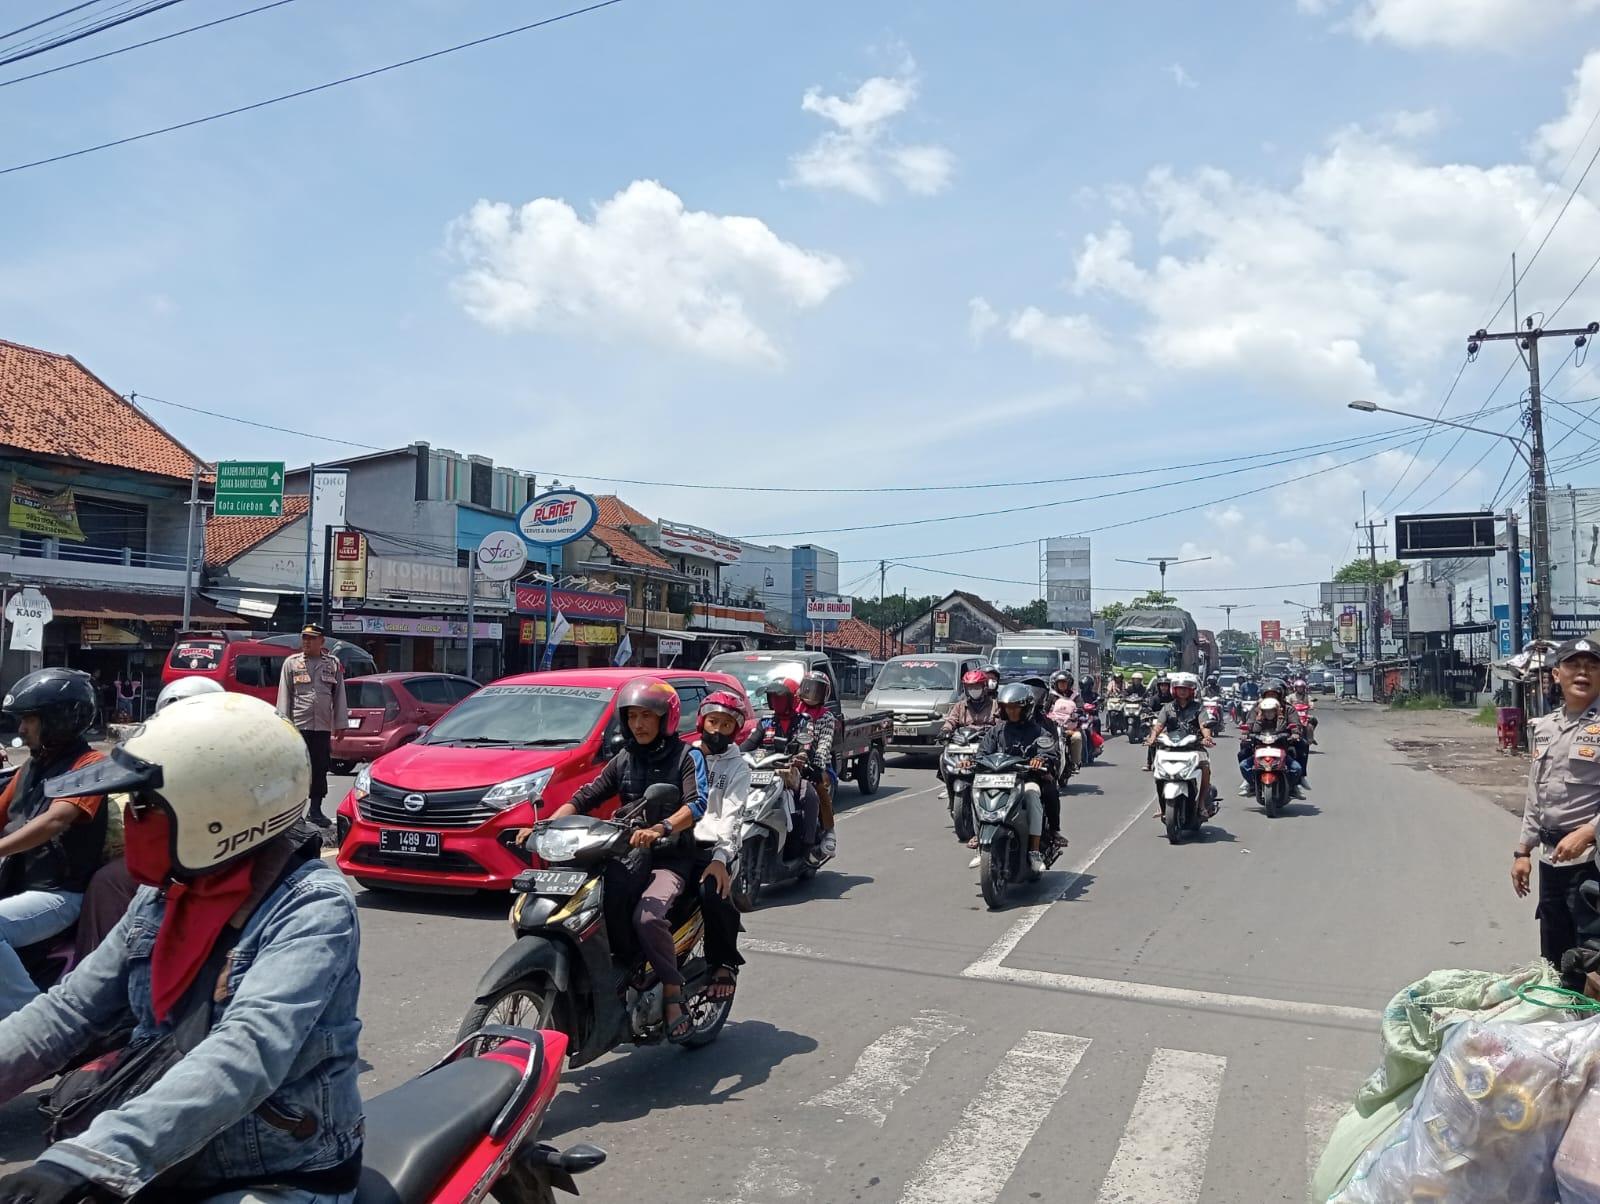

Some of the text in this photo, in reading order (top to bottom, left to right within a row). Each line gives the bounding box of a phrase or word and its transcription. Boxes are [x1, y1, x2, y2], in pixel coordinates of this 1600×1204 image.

[218, 501, 264, 511] Kota Cirebon
[534, 501, 578, 521] PLANET
[388, 559, 464, 584] KOSMETIK
[808, 602, 825, 612] SARI
[16, 608, 42, 619] KAOS
[1560, 620, 1587, 630] UTAMA
[520, 687, 602, 699] HANJUANG
[213, 821, 267, 860] JPN
[381, 831, 437, 847] E 1489 ZD
[568, 874, 585, 884] RJ
